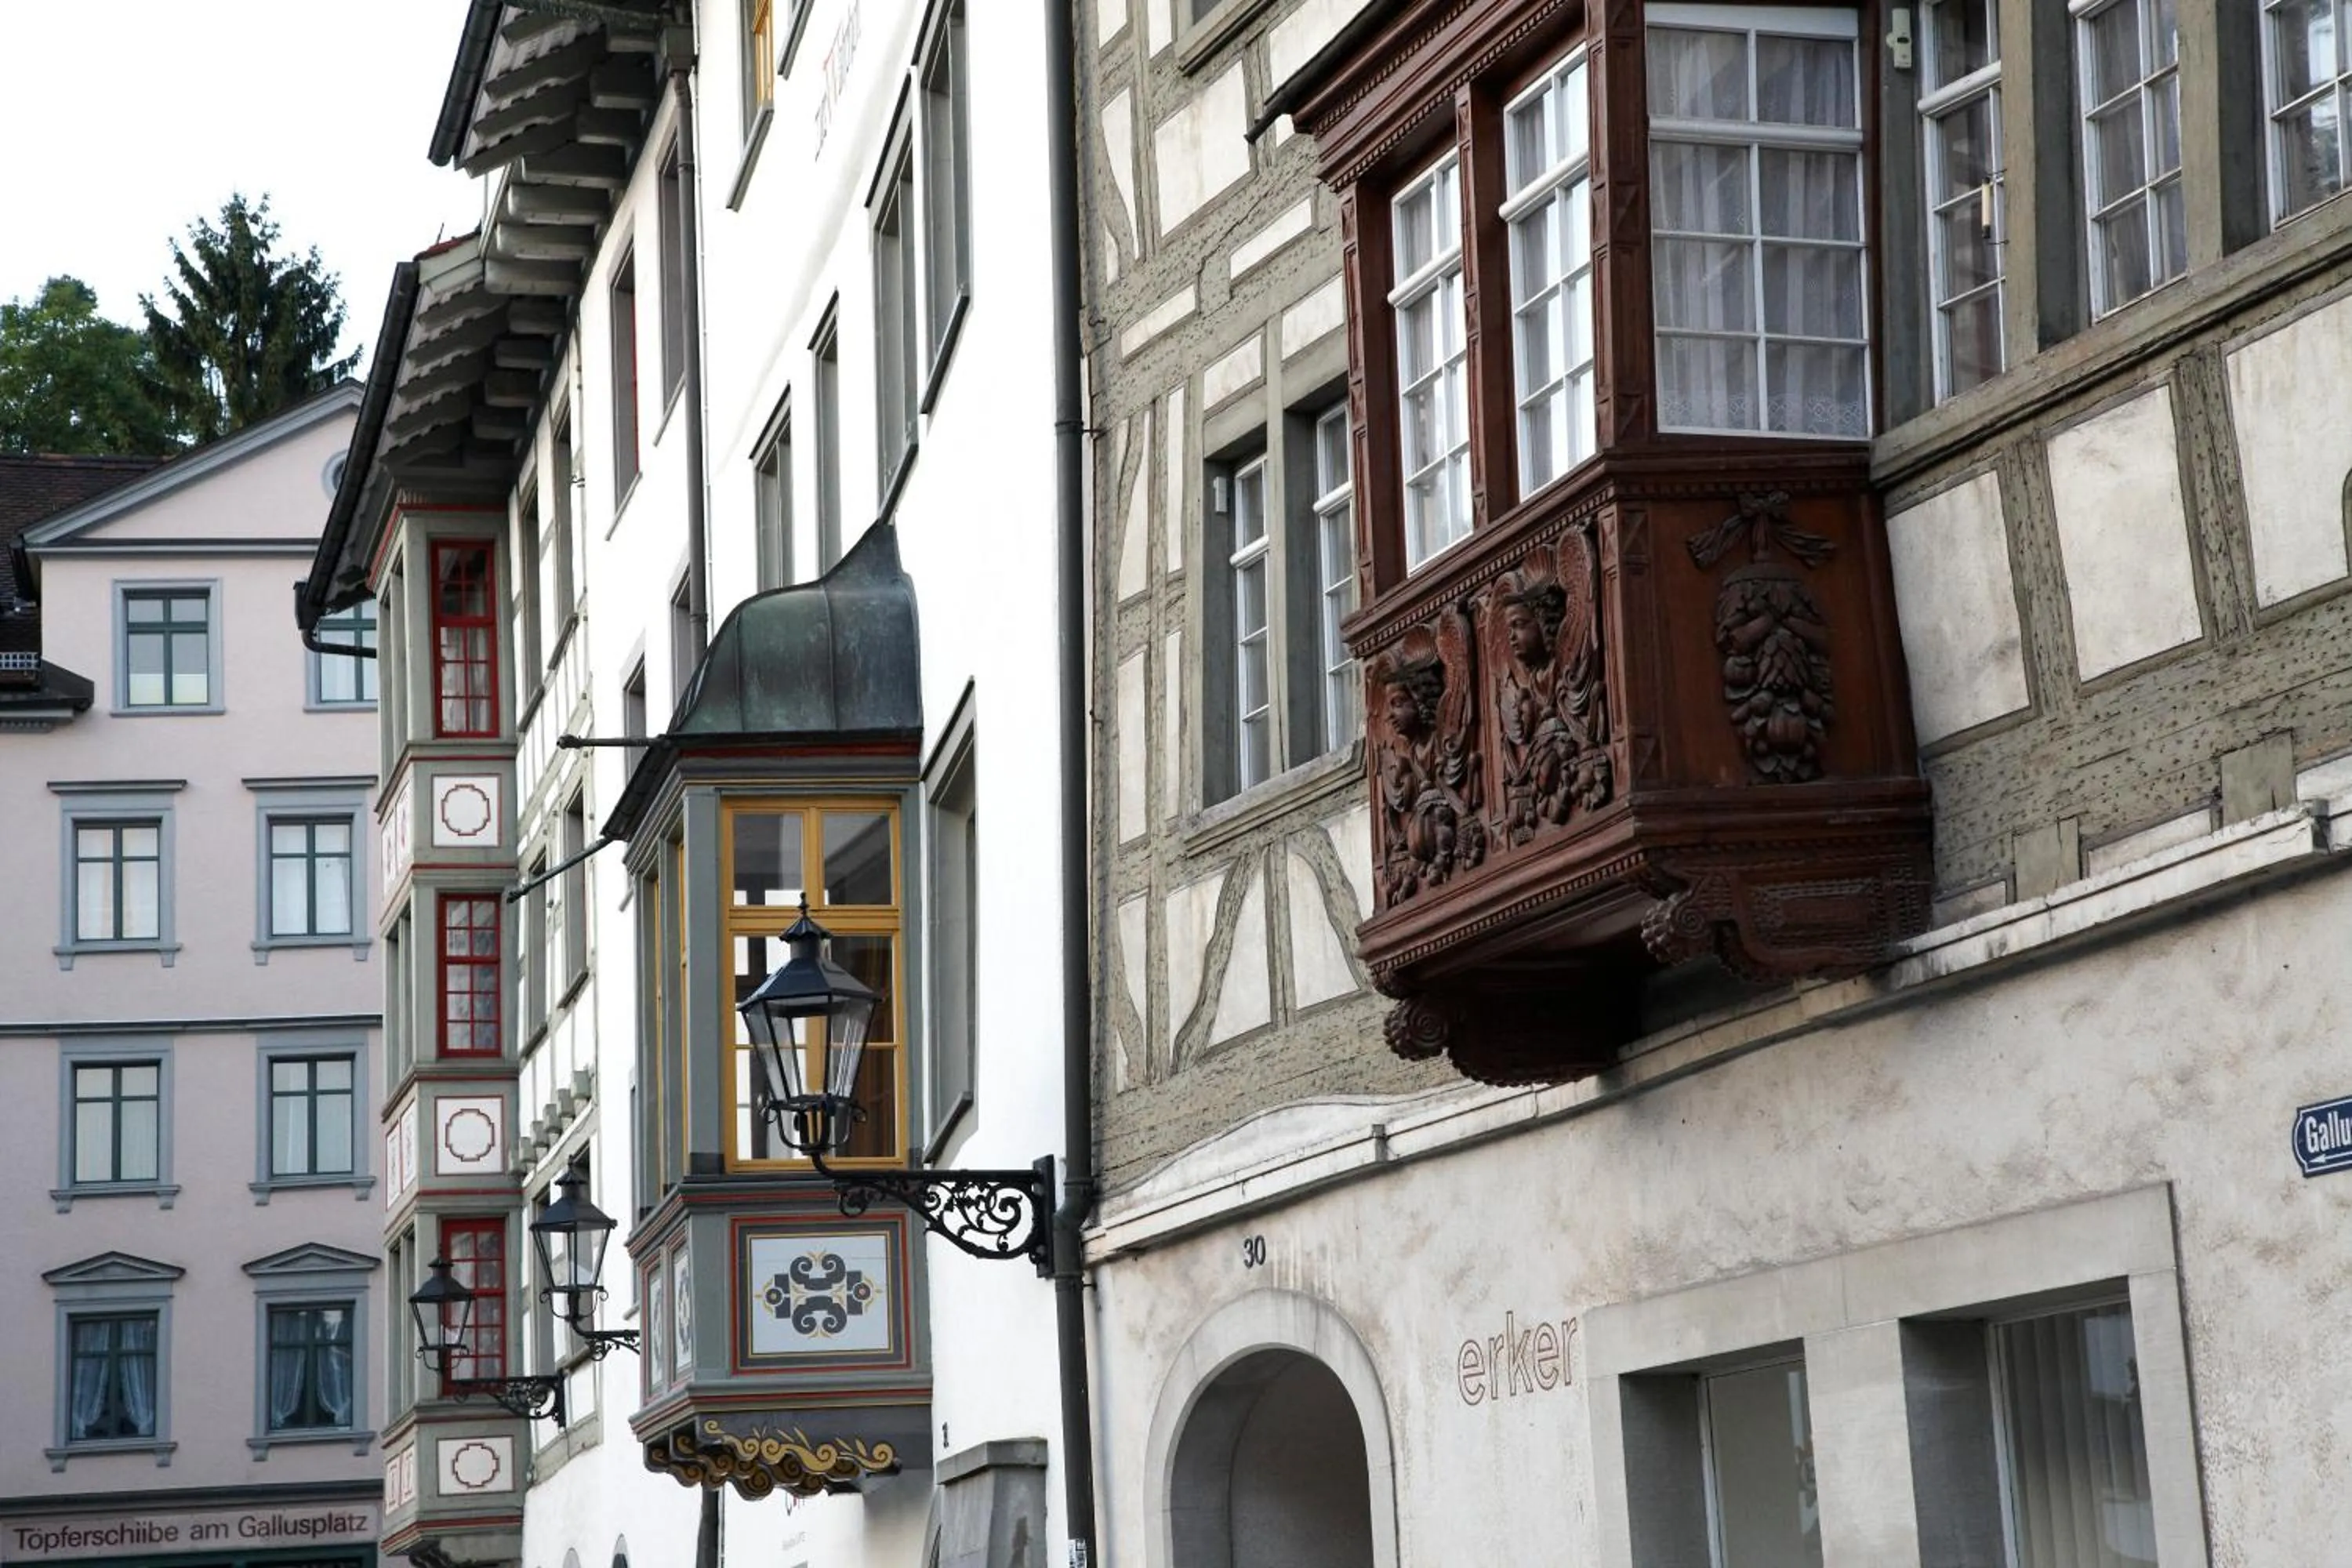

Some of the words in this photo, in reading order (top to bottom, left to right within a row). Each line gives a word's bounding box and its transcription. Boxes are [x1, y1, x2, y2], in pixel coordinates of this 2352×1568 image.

[2306, 1110, 2352, 1153] Gallu
[1243, 1235, 1266, 1269] 30
[1457, 1310, 1577, 1406] erker
[190, 1523, 229, 1541] am
[238, 1512, 368, 1538] Gallusplatz
